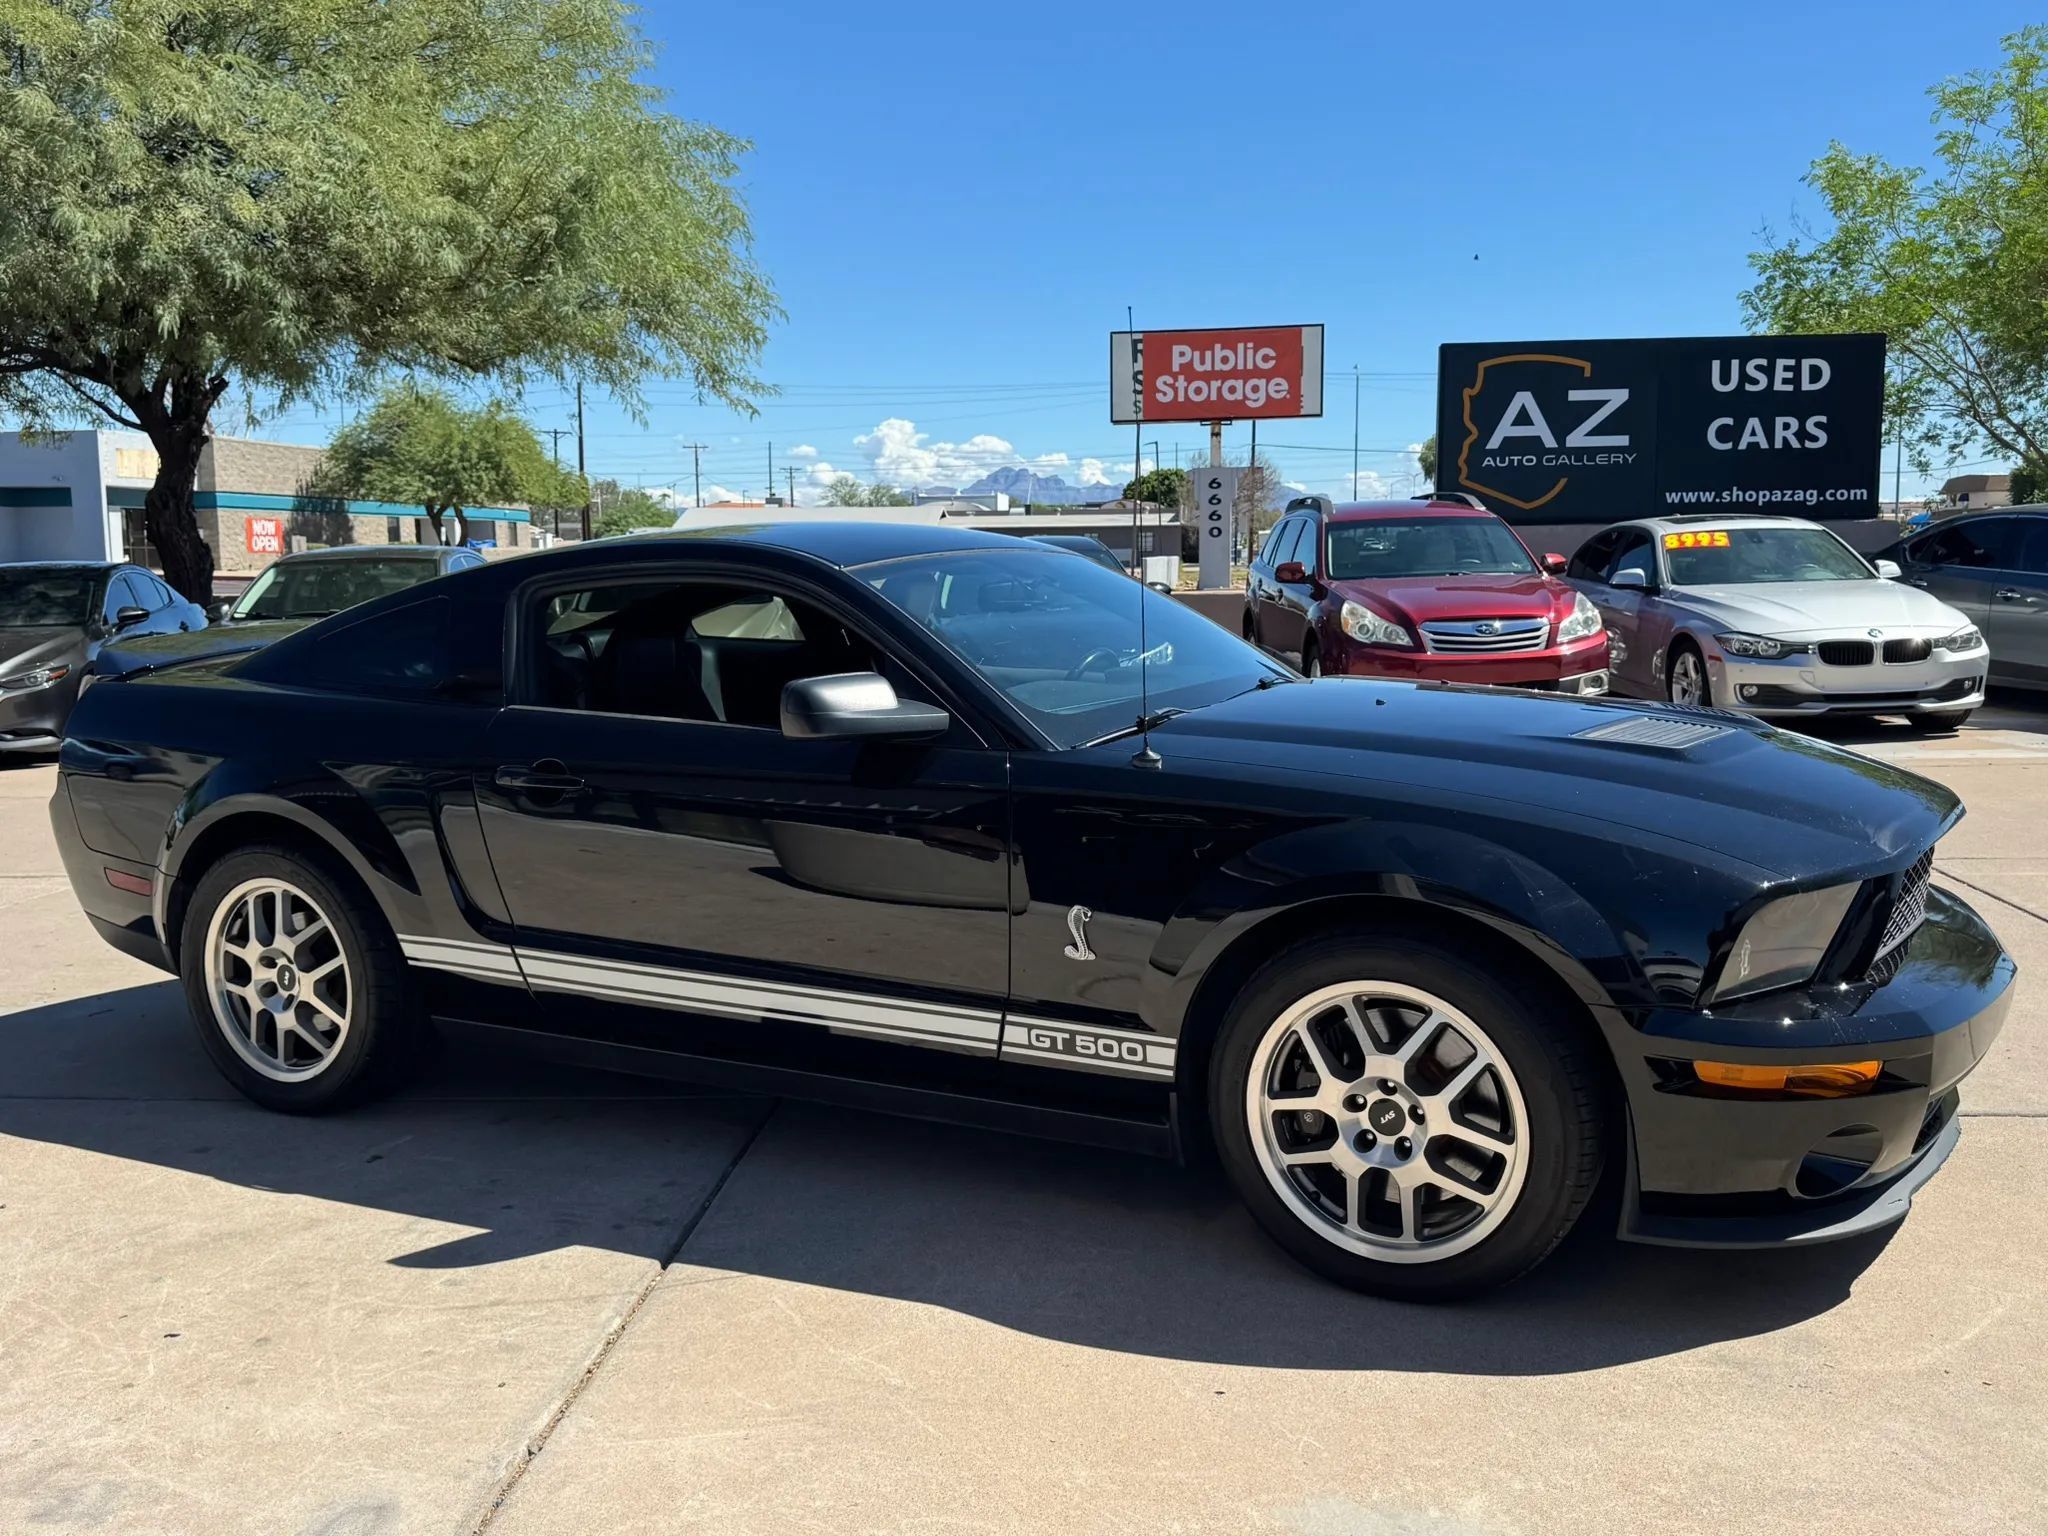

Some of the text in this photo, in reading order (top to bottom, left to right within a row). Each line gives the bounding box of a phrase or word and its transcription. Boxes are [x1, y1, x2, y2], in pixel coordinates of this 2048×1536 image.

[1172, 342, 1277, 372] Public
[1710, 357, 1831, 392] USED
[1484, 388, 1631, 450] AZ
[1706, 415, 1829, 451] CARS
[1481, 453, 1638, 467] AUTO GALLERY
[1208, 478, 1222, 538] 6660
[1665, 486, 1868, 506] www.shopazag.com
[252, 519, 276, 535] NOW
[1664, 531, 1729, 549] 8995
[252, 535, 280, 552] OPEN
[1030, 1028, 1144, 1061] GT 500
